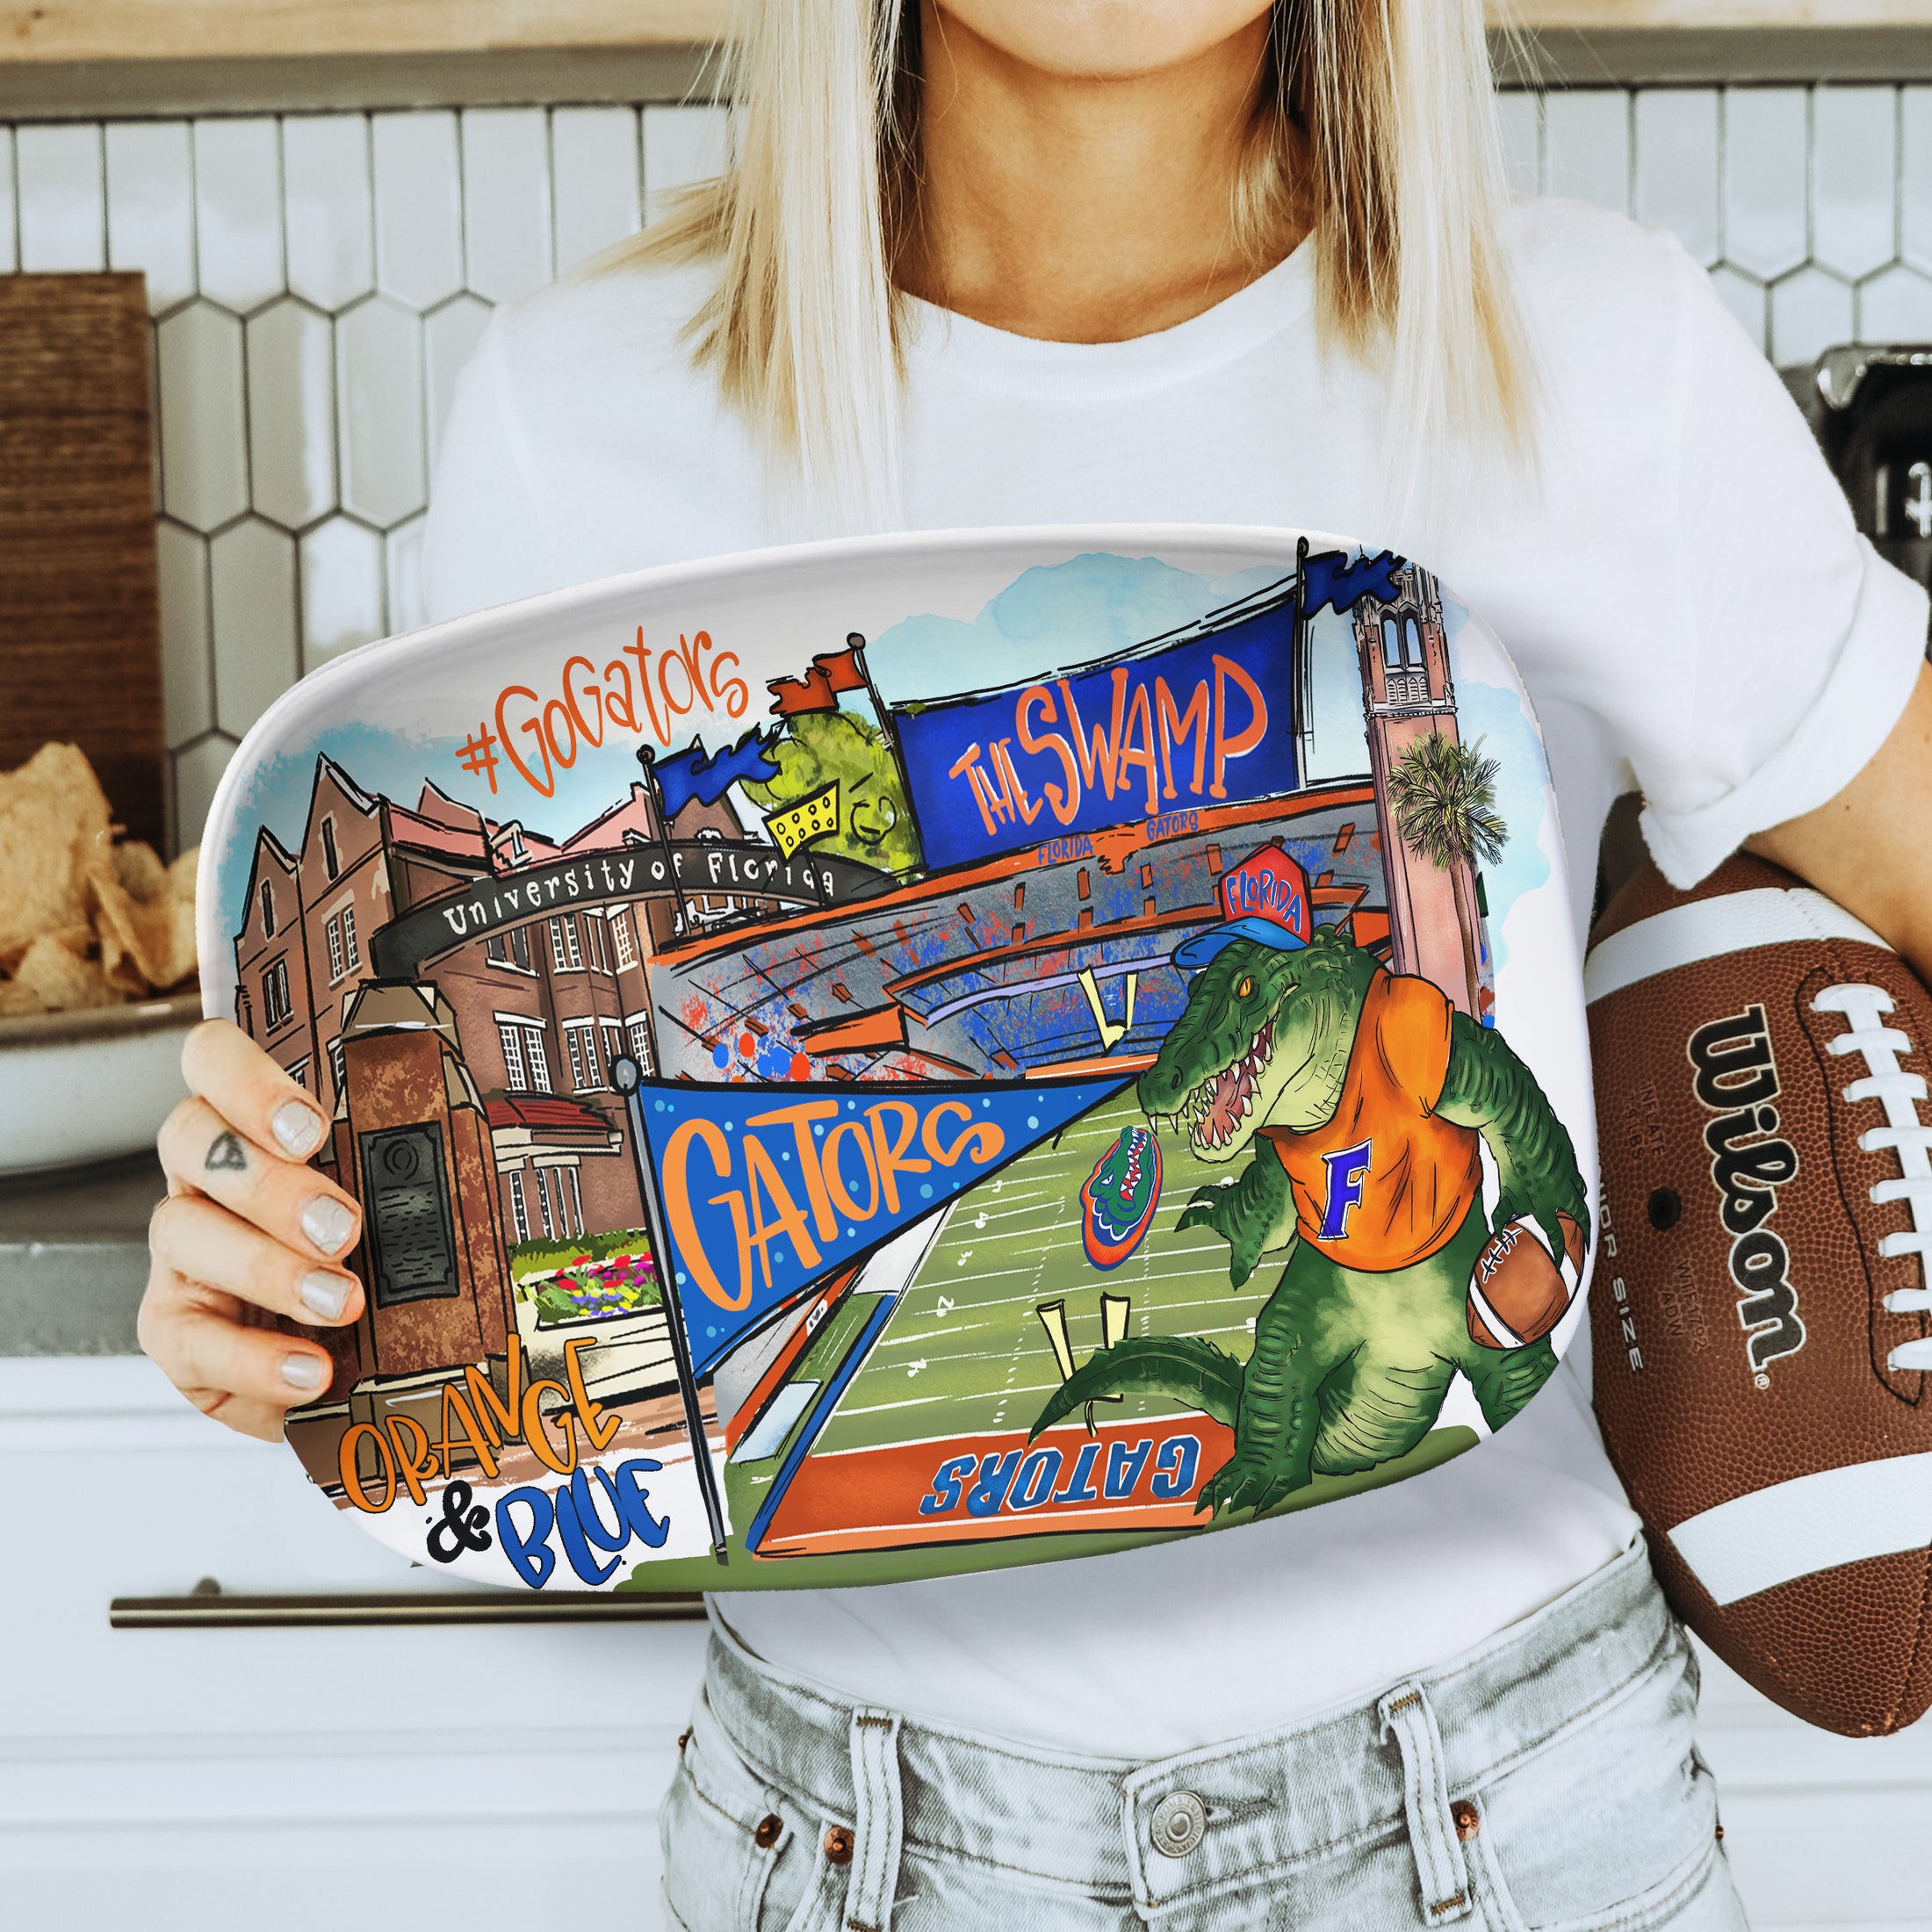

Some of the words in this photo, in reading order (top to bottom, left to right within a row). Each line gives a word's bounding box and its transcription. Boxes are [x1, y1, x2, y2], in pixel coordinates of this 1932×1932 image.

[455, 625, 748, 798] #GoGators
[948, 738, 1044, 836] THE
[1015, 653, 1268, 825] SWAMP
[1038, 835, 1093, 865] FLORIDA
[1146, 811, 1199, 841] GATORS
[443, 859, 634, 934] University
[651, 853, 683, 880] of
[1226, 869, 1301, 934] FLORIDA
[1627, 1124, 1645, 1160] LBS
[1640, 1084, 1665, 1157] INFLATE
[662, 1099, 1005, 1311] GATORS
[1317, 1137, 1372, 1242] F
[1687, 1003, 1807, 1373] Wilson
[1612, 1276, 1644, 1372] SIZE
[1662, 1291, 1683, 1337] ADW
[1677, 1259, 1708, 1354] WTF1792
[338, 1332, 622, 1513] ORANGE
[919, 1434, 1201, 1517] GATORS
[426, 1480, 492, 1563] &
[495, 1459, 670, 1589] BLUE
